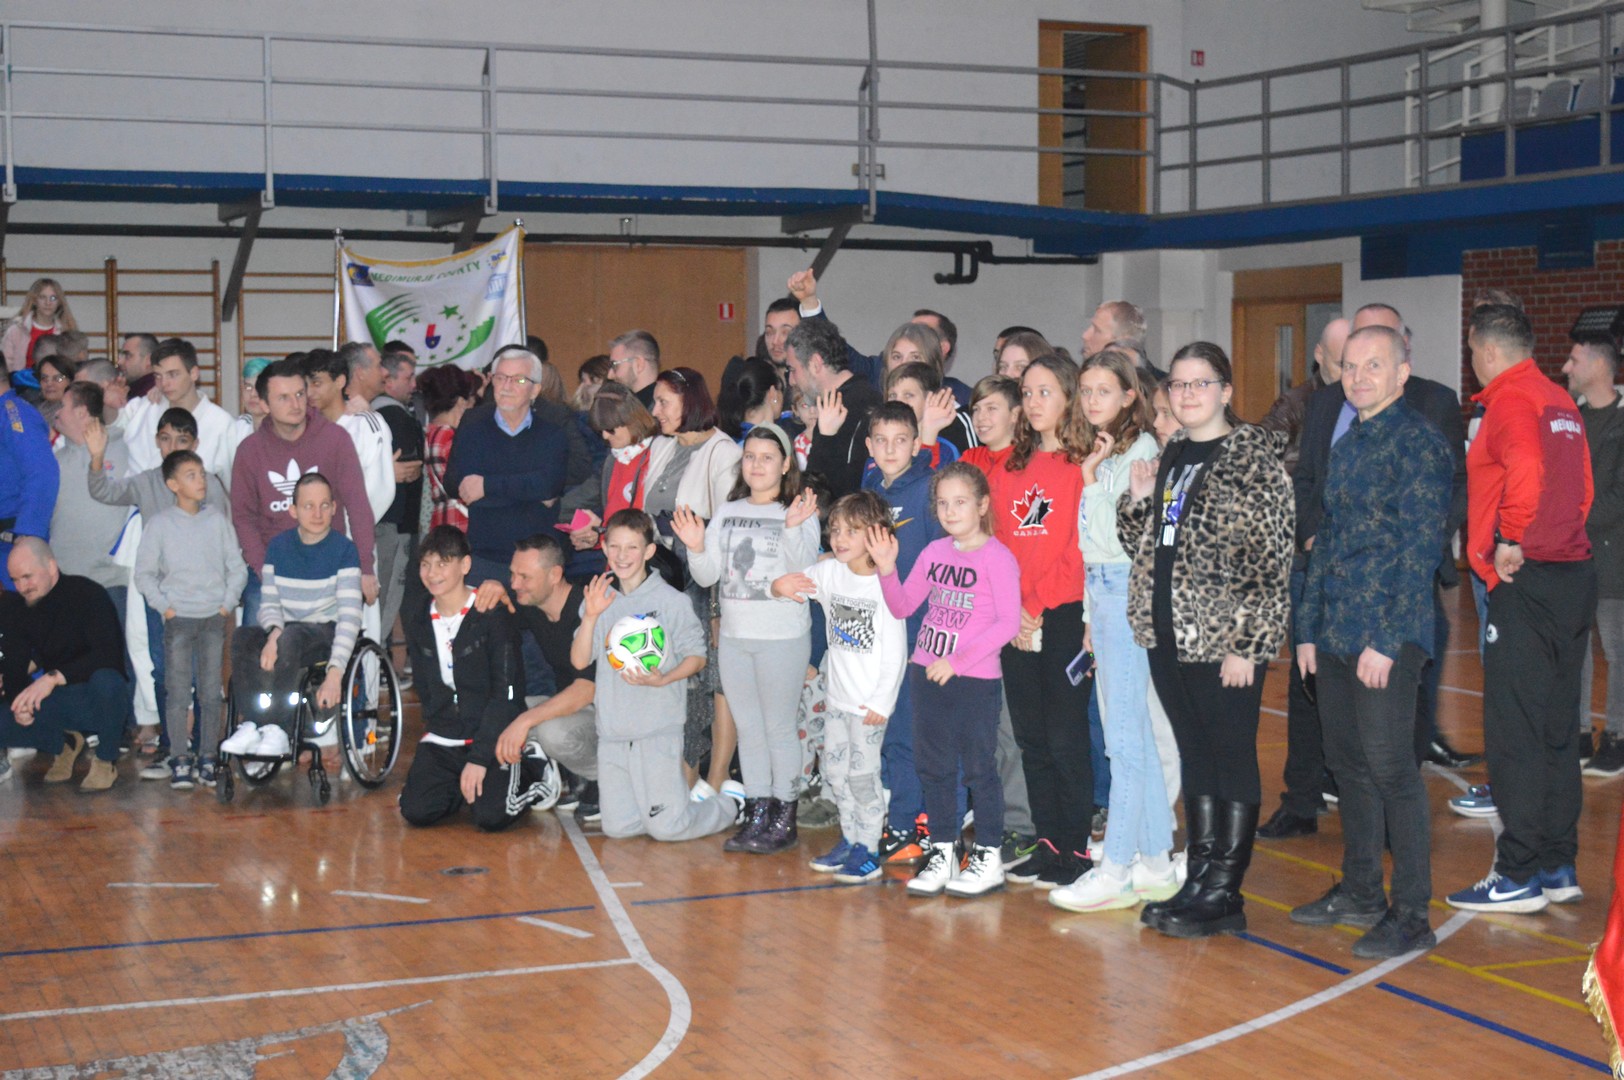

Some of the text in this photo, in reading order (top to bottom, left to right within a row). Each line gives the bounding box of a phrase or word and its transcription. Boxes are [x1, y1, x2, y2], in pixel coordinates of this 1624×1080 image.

[722, 518, 761, 529] PARIS
[926, 562, 977, 588] KIND
[940, 588, 976, 610] THE
